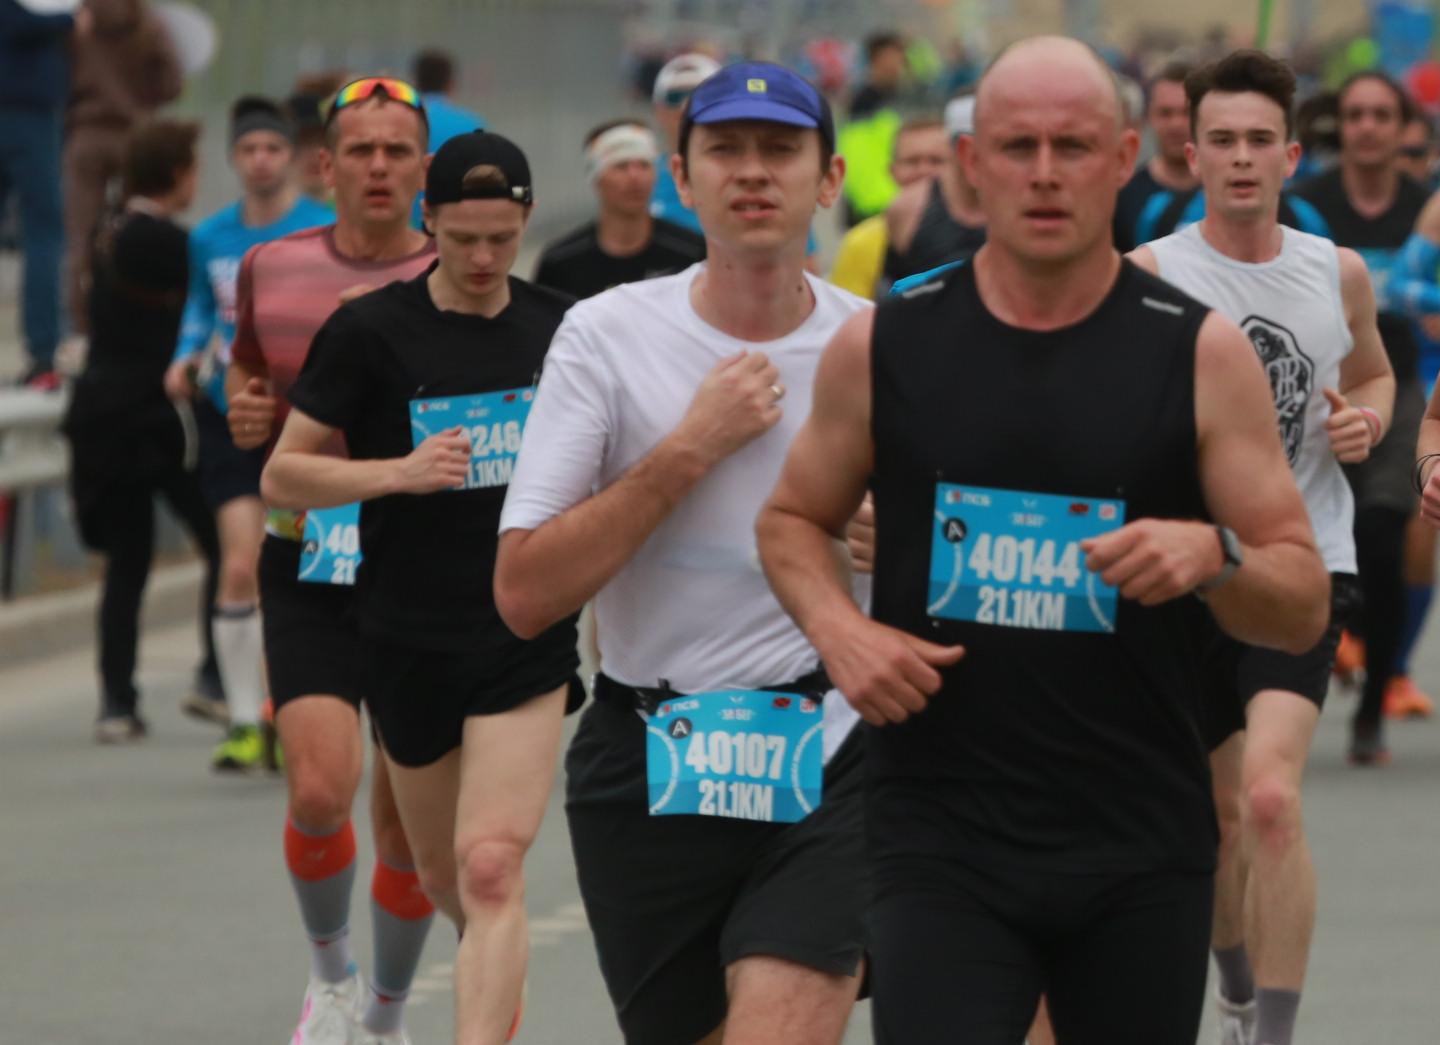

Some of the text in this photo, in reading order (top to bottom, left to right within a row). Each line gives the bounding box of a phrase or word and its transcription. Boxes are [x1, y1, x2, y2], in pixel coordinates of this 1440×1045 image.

[968, 533, 1081, 588] 40144
[976, 585, 1067, 631] 21.1KM
[672, 720, 689, 736] A
[685, 731, 787, 780] 40107
[698, 778, 773, 822] 21.1KM
